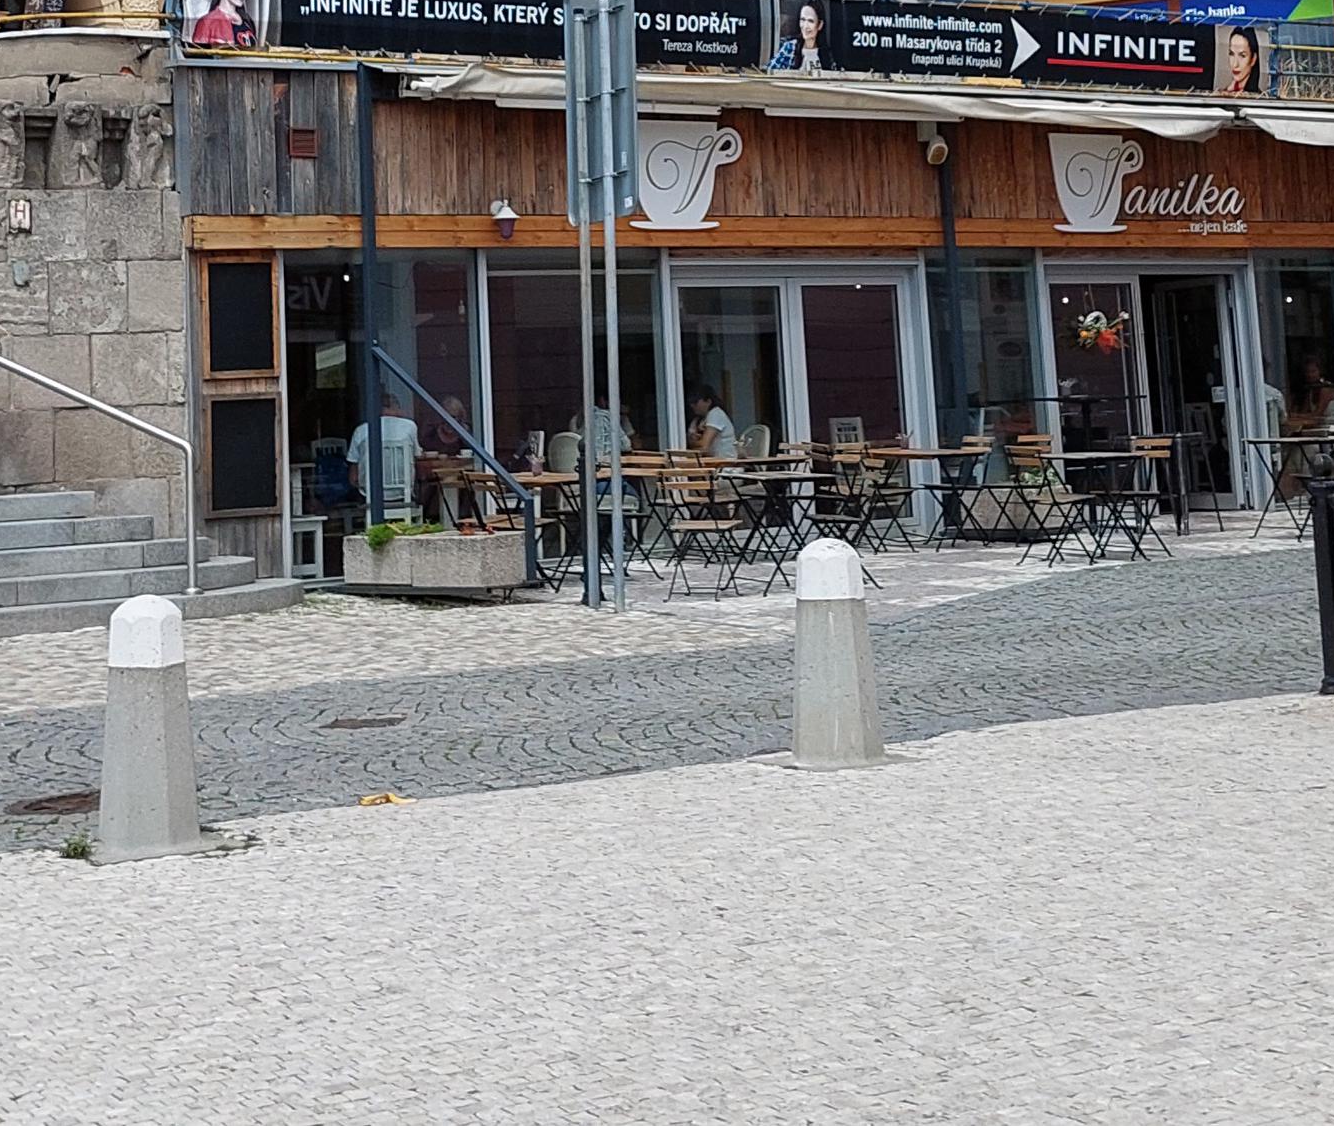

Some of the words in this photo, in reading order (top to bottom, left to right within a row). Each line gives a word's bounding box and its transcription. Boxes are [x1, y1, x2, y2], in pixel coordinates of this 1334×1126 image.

[424, 0, 488, 24] LUXUS,
[494, 2, 549, 25] KTERÝ
[655, 13, 671, 31] SI
[1208, 4, 1245, 18] banka
[862, 13, 1002, 34] www.infinite-infinite.com
[662, 38, 693, 52] Tereza
[695, 40, 738, 54] Kostková
[852, 31, 878, 47] 200
[880, 36, 893, 48] m
[895, 33, 962, 53] Masarykova
[965, 37, 991, 53] třída
[994, 39, 1002, 54] 2
[1057, 30, 1196, 62] INFINITE
[911, 53, 944, 66] (naproti
[946, 54, 964, 66] ulici
[14, 202, 26, 220] H
[1222, 219, 1248, 234] kafe
